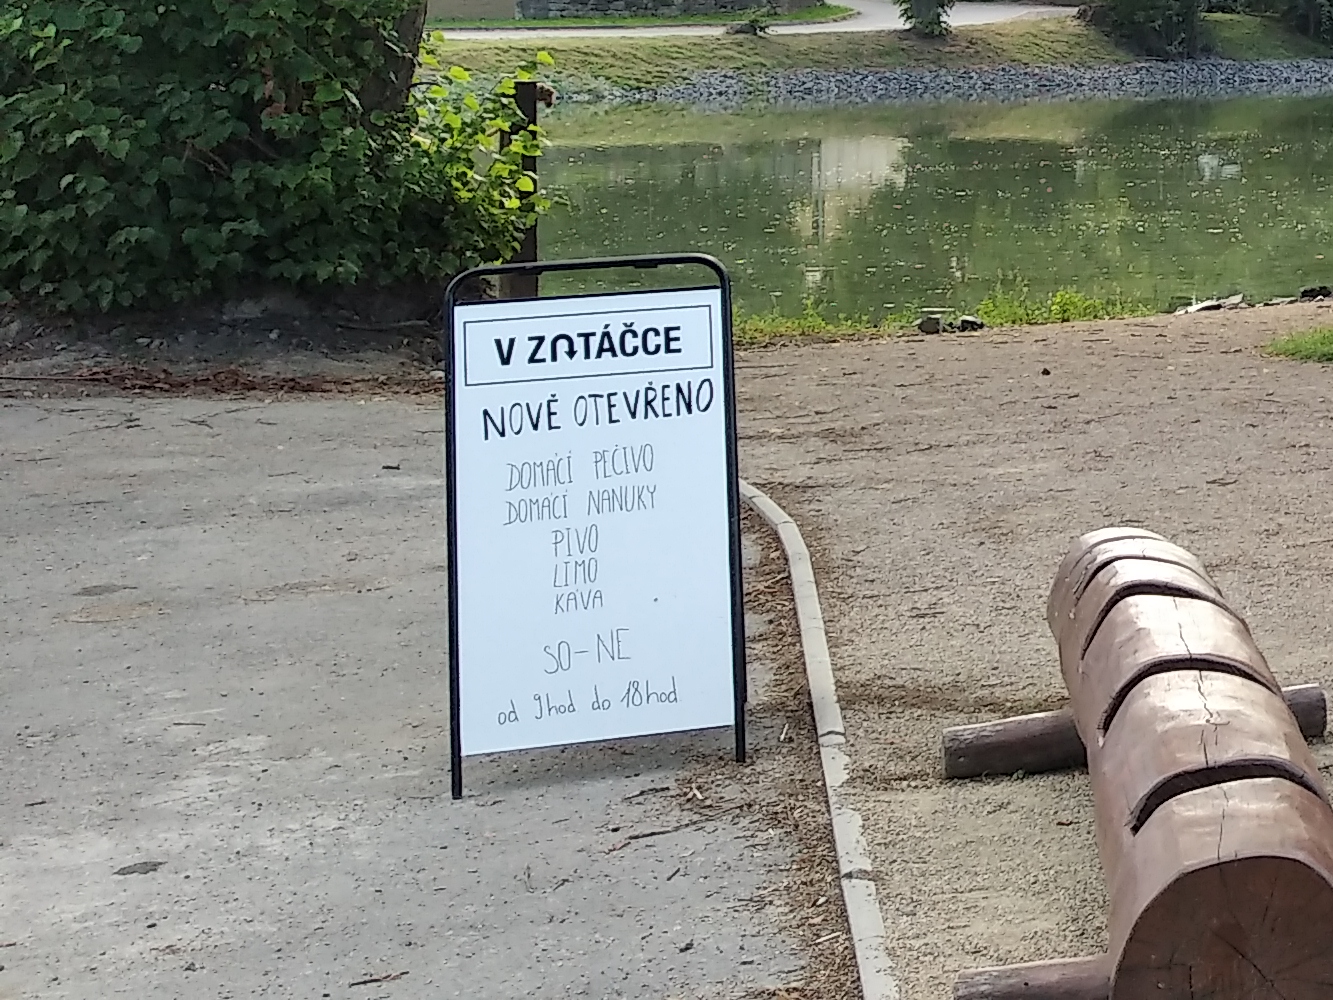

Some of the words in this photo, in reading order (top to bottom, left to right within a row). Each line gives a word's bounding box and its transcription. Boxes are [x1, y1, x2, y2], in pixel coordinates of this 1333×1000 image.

[494, 337, 516, 366] V
[482, 393, 561, 441] NOVĚ
[573, 378, 714, 427] OTEVŘENO
[505, 450, 573, 491] DOMÁCÍ
[503, 489, 568, 526] DOMÁCÍ
[587, 484, 656, 516] NANUKY
[551, 523, 599, 557] PIVO
[553, 557, 598, 588] LIMO
[554, 588, 603, 615] KÁVA
[497, 699, 519, 725] od
[591, 684, 611, 711] do
